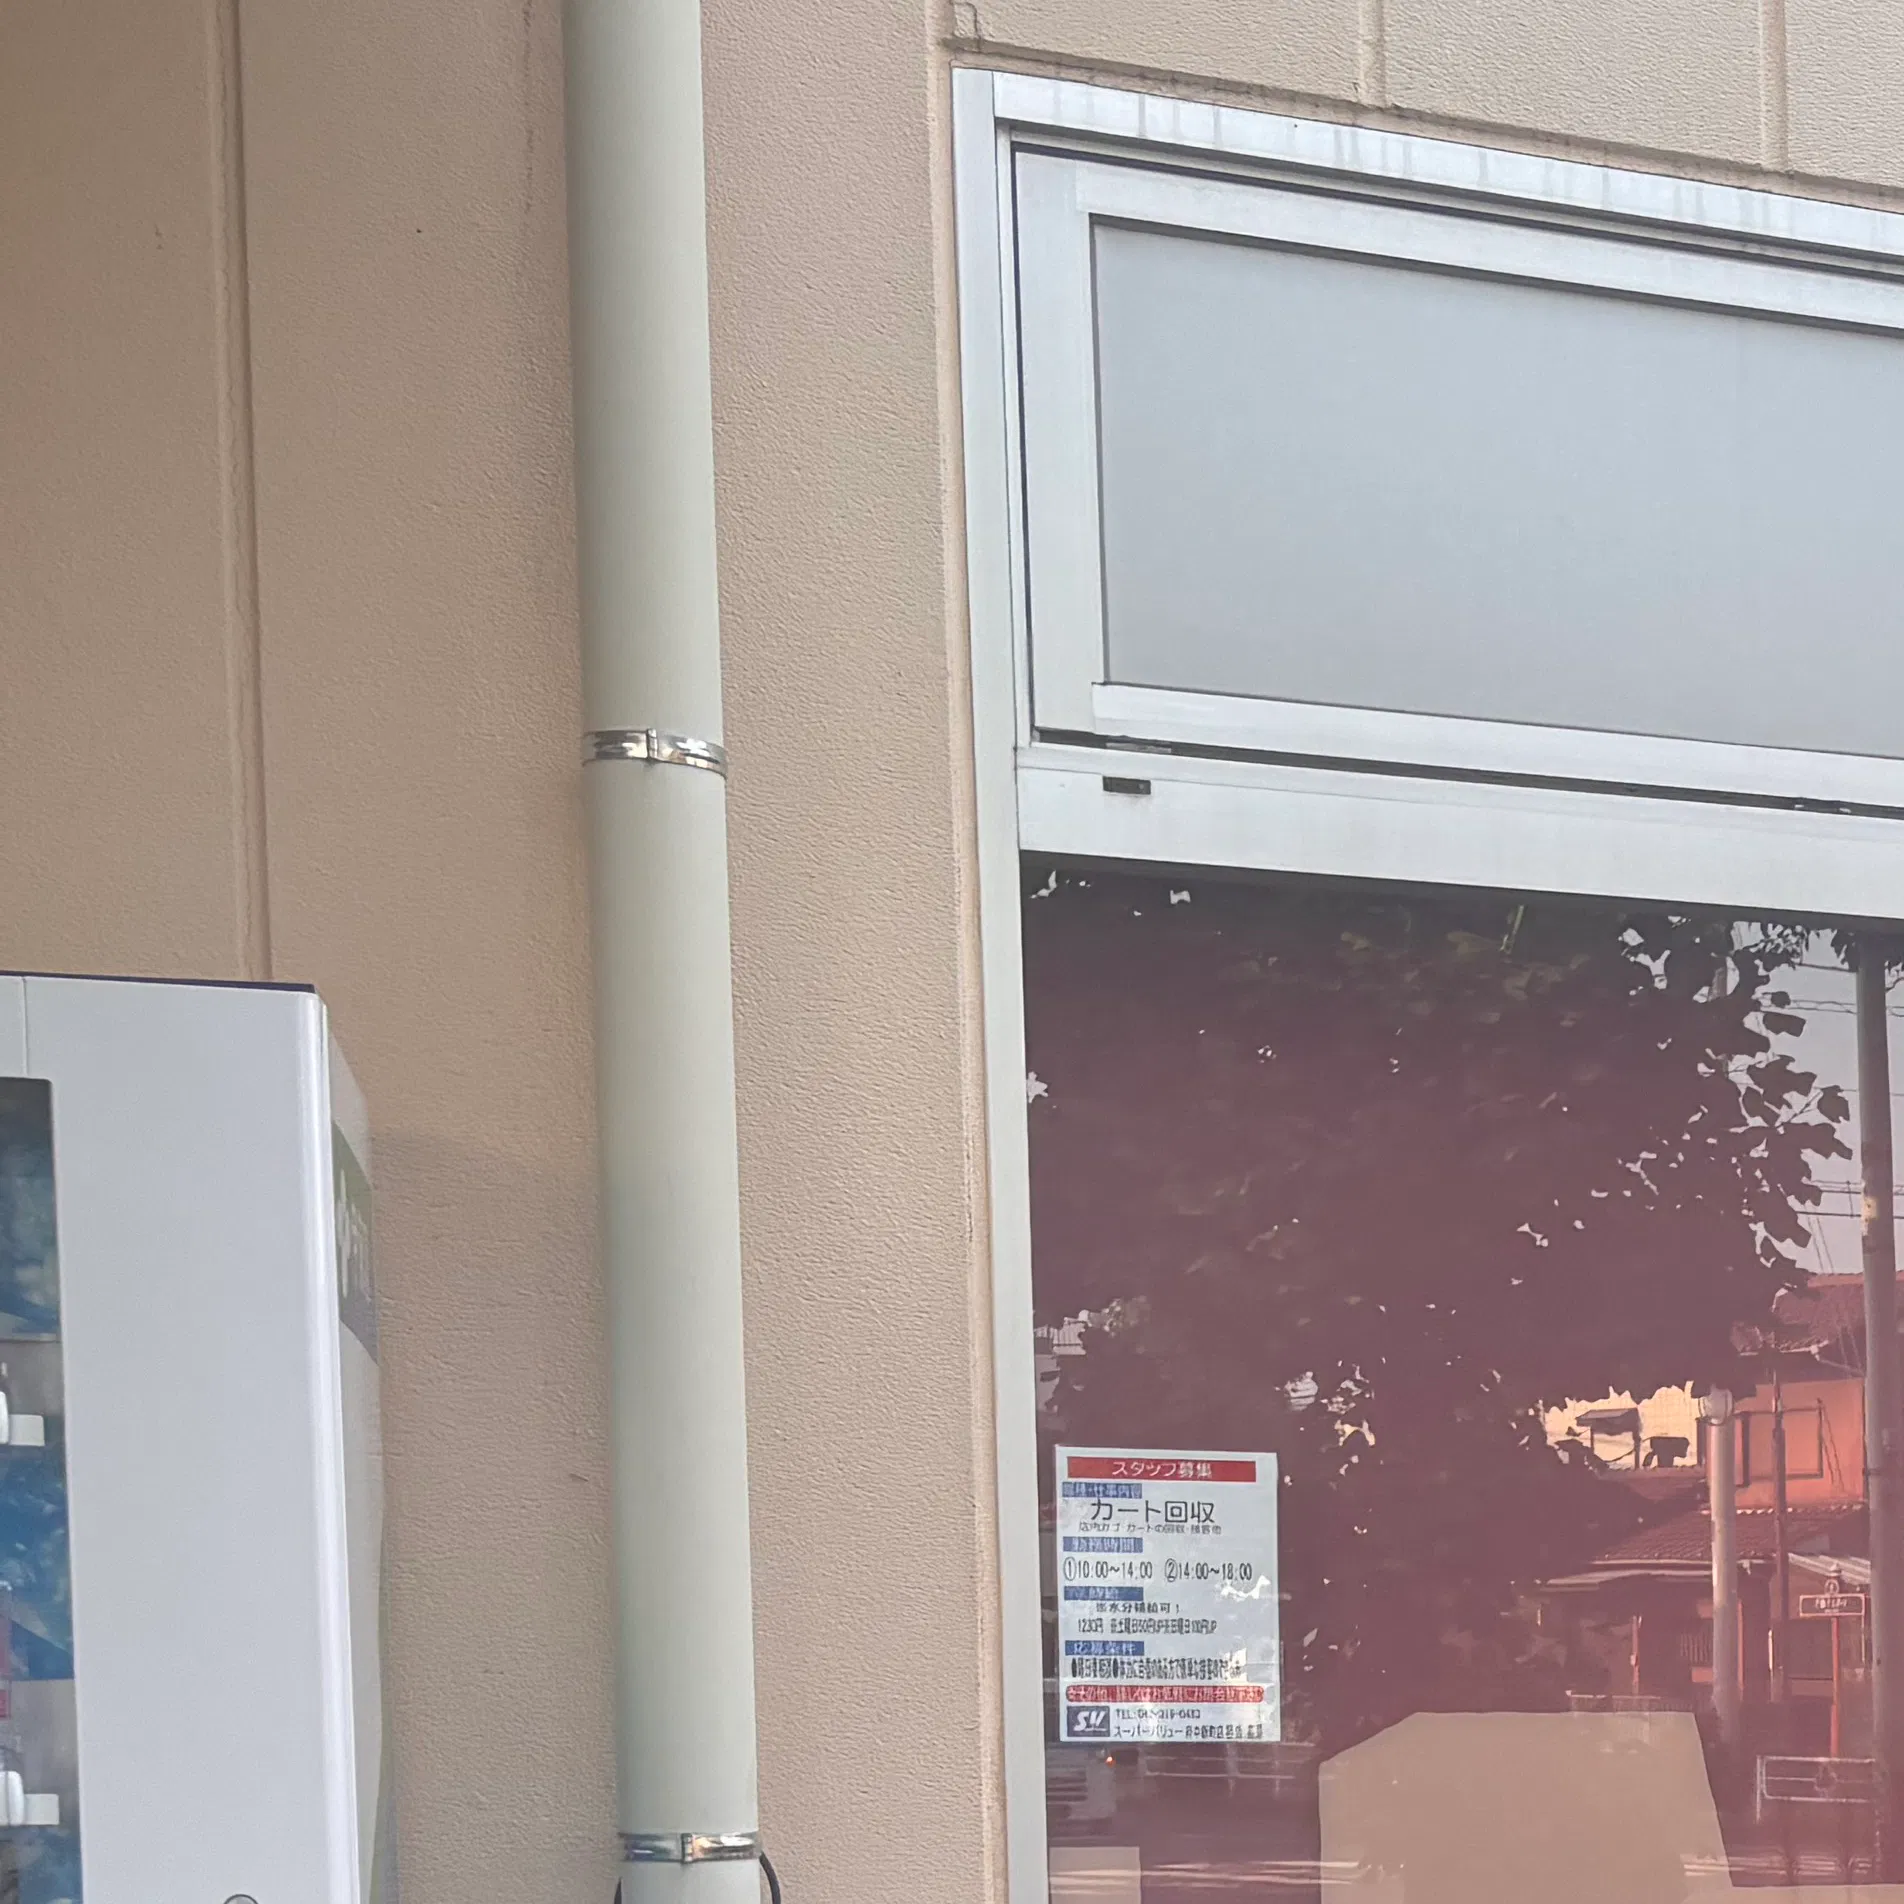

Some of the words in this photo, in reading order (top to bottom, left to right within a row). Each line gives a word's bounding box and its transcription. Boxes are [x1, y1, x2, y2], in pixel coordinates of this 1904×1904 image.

[1111, 1459, 1213, 1479] スタッフ募集
[1090, 1499, 1216, 1525] カート回収
